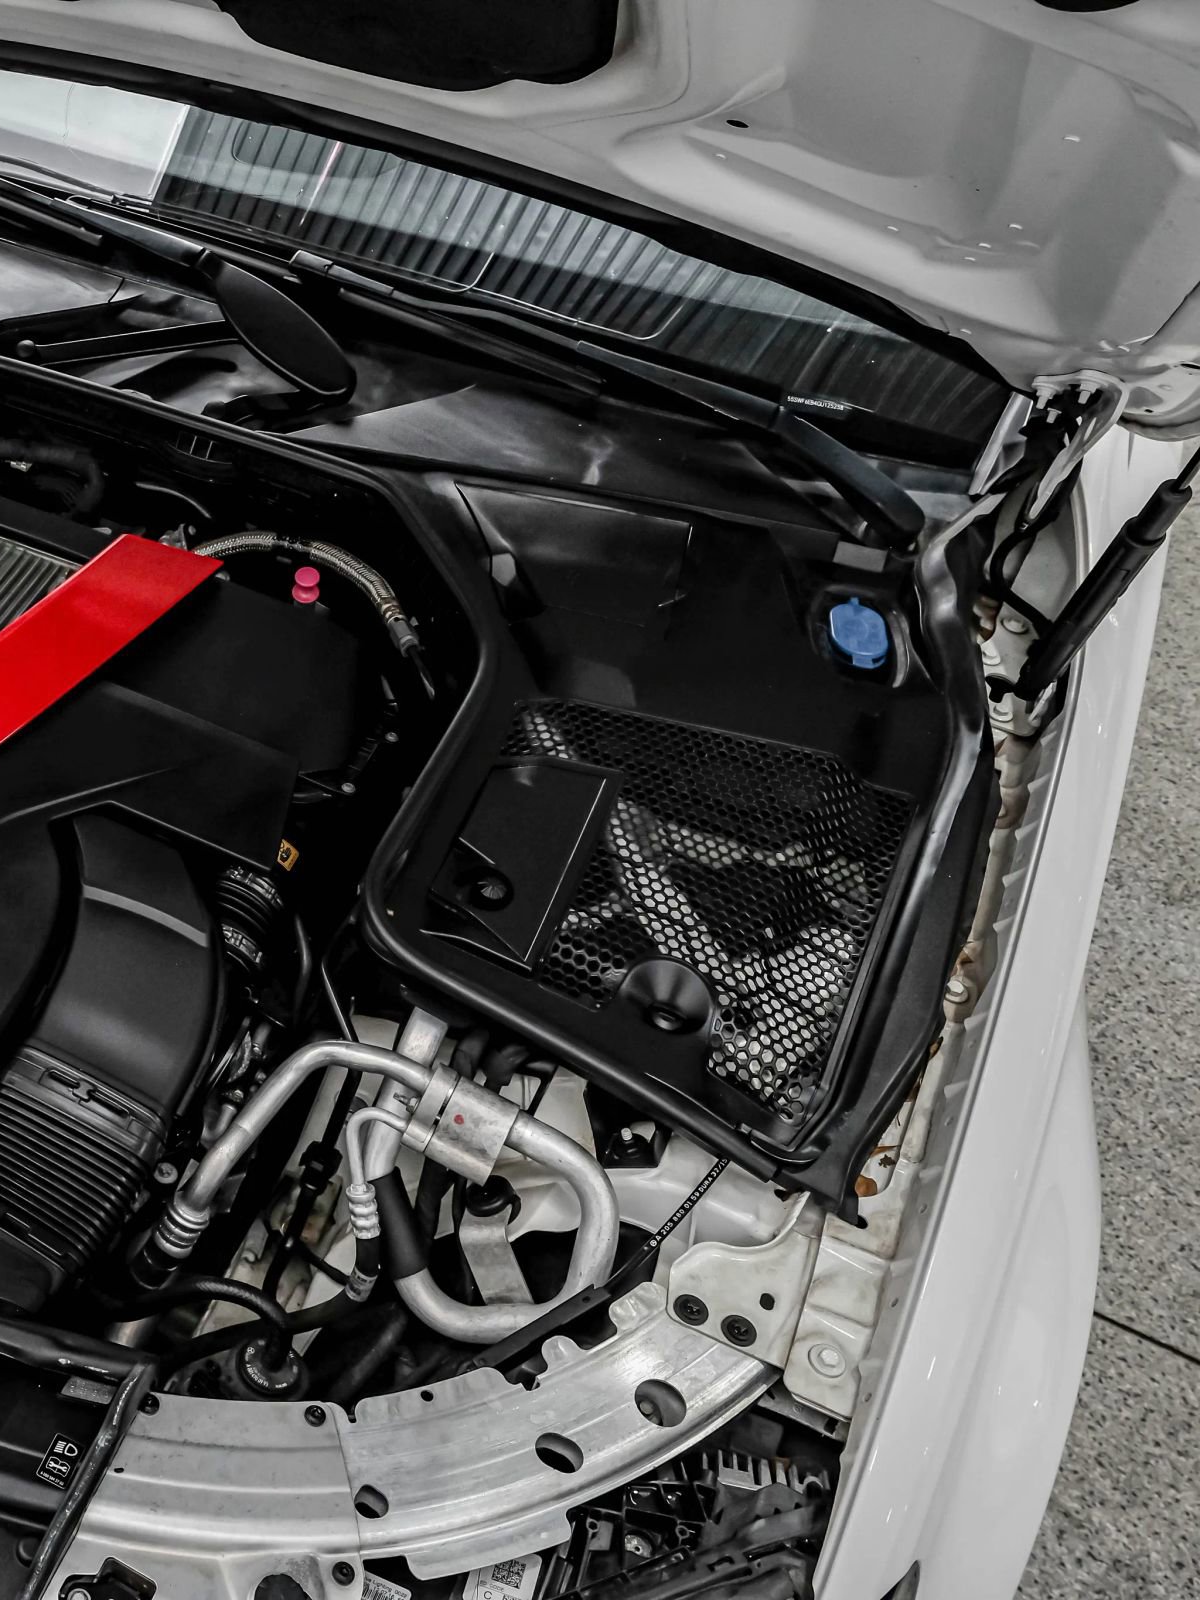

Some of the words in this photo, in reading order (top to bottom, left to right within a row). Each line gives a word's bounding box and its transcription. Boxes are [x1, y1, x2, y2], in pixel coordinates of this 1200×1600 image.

[660, 1221, 673, 1235] 205
[683, 1200, 693, 1209] 01
[698, 1176, 713, 1193] DURA
